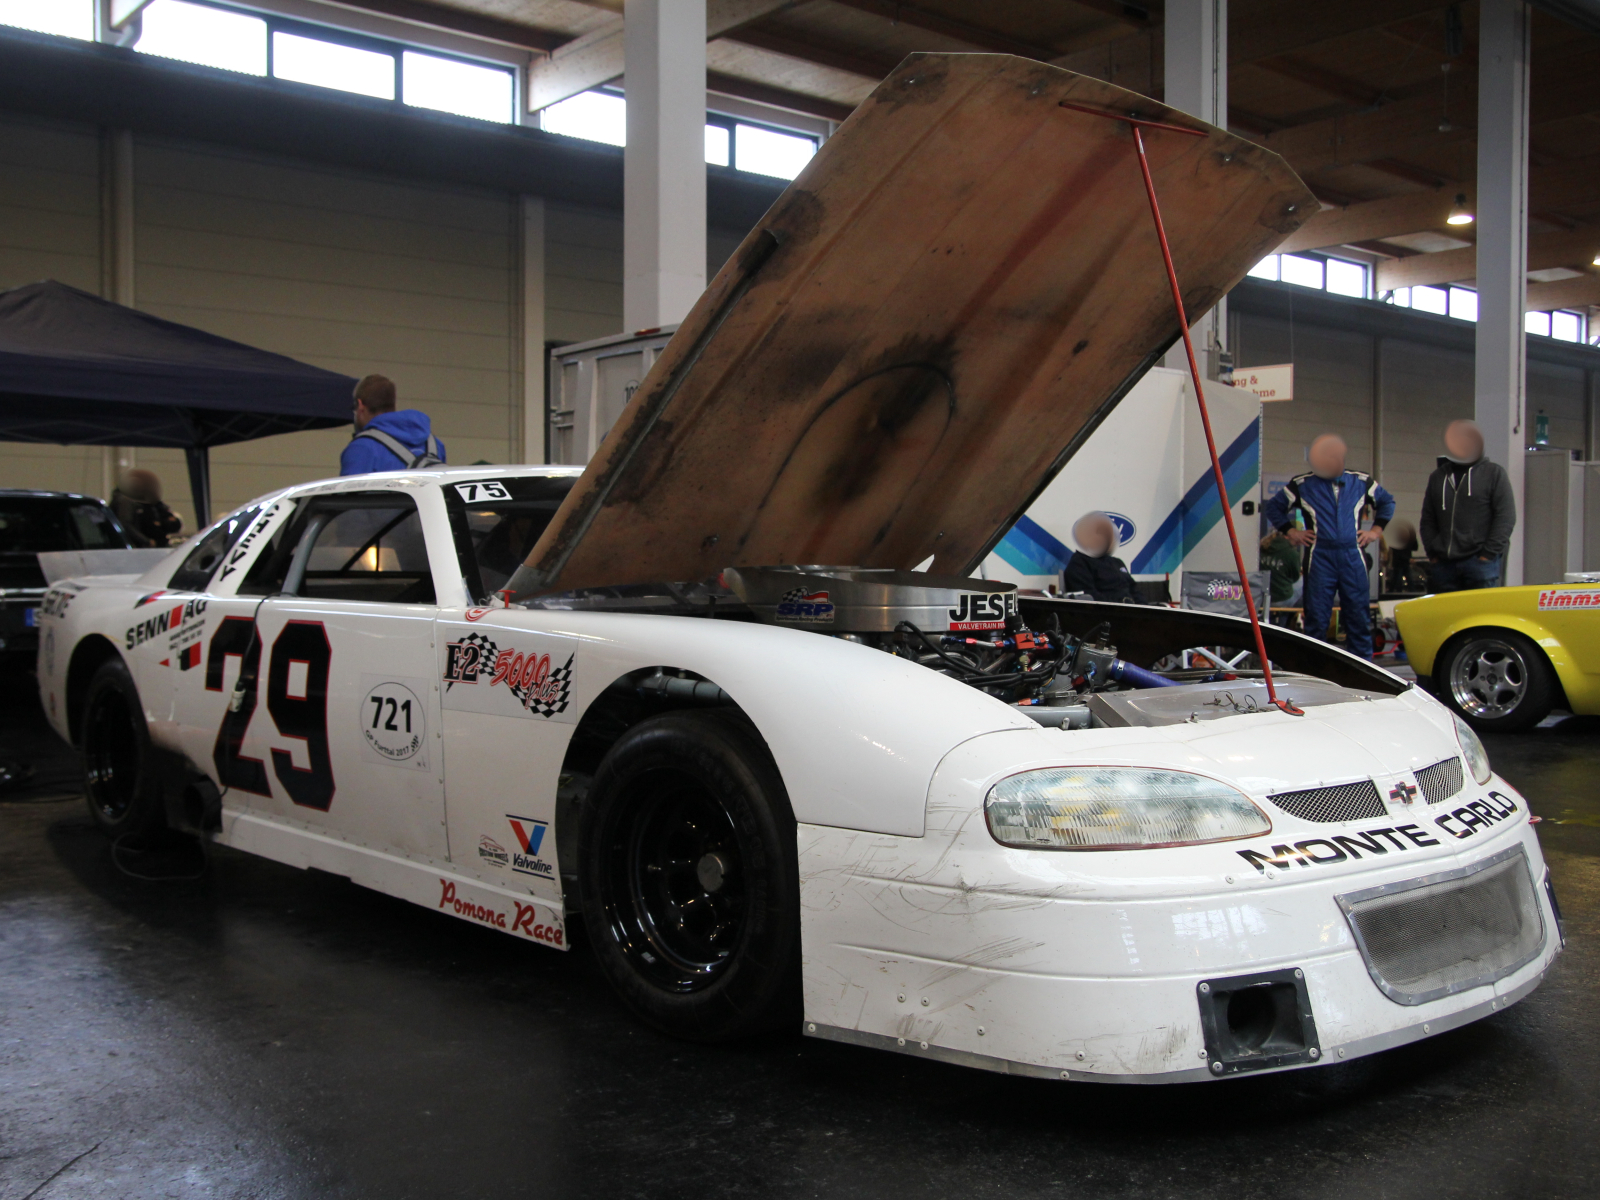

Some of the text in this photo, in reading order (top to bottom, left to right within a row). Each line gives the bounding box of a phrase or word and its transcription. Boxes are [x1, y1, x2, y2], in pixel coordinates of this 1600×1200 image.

[1250, 375, 1258, 385] &
[459, 483, 507, 501] 75
[1539, 590, 1600, 607] timms
[776, 603, 834, 616] SRP
[958, 622, 997, 631] VALVETRAIN
[443, 642, 480, 685] E2
[490, 648, 550, 688] 5000
[205, 615, 336, 813] 29
[371, 696, 411, 733] 721
[395, 745, 410, 756] 2017
[1236, 790, 1517, 874] MONTE CARLO
[513, 853, 553, 874] Valvoline
[439, 878, 563, 945] Pomona Race
